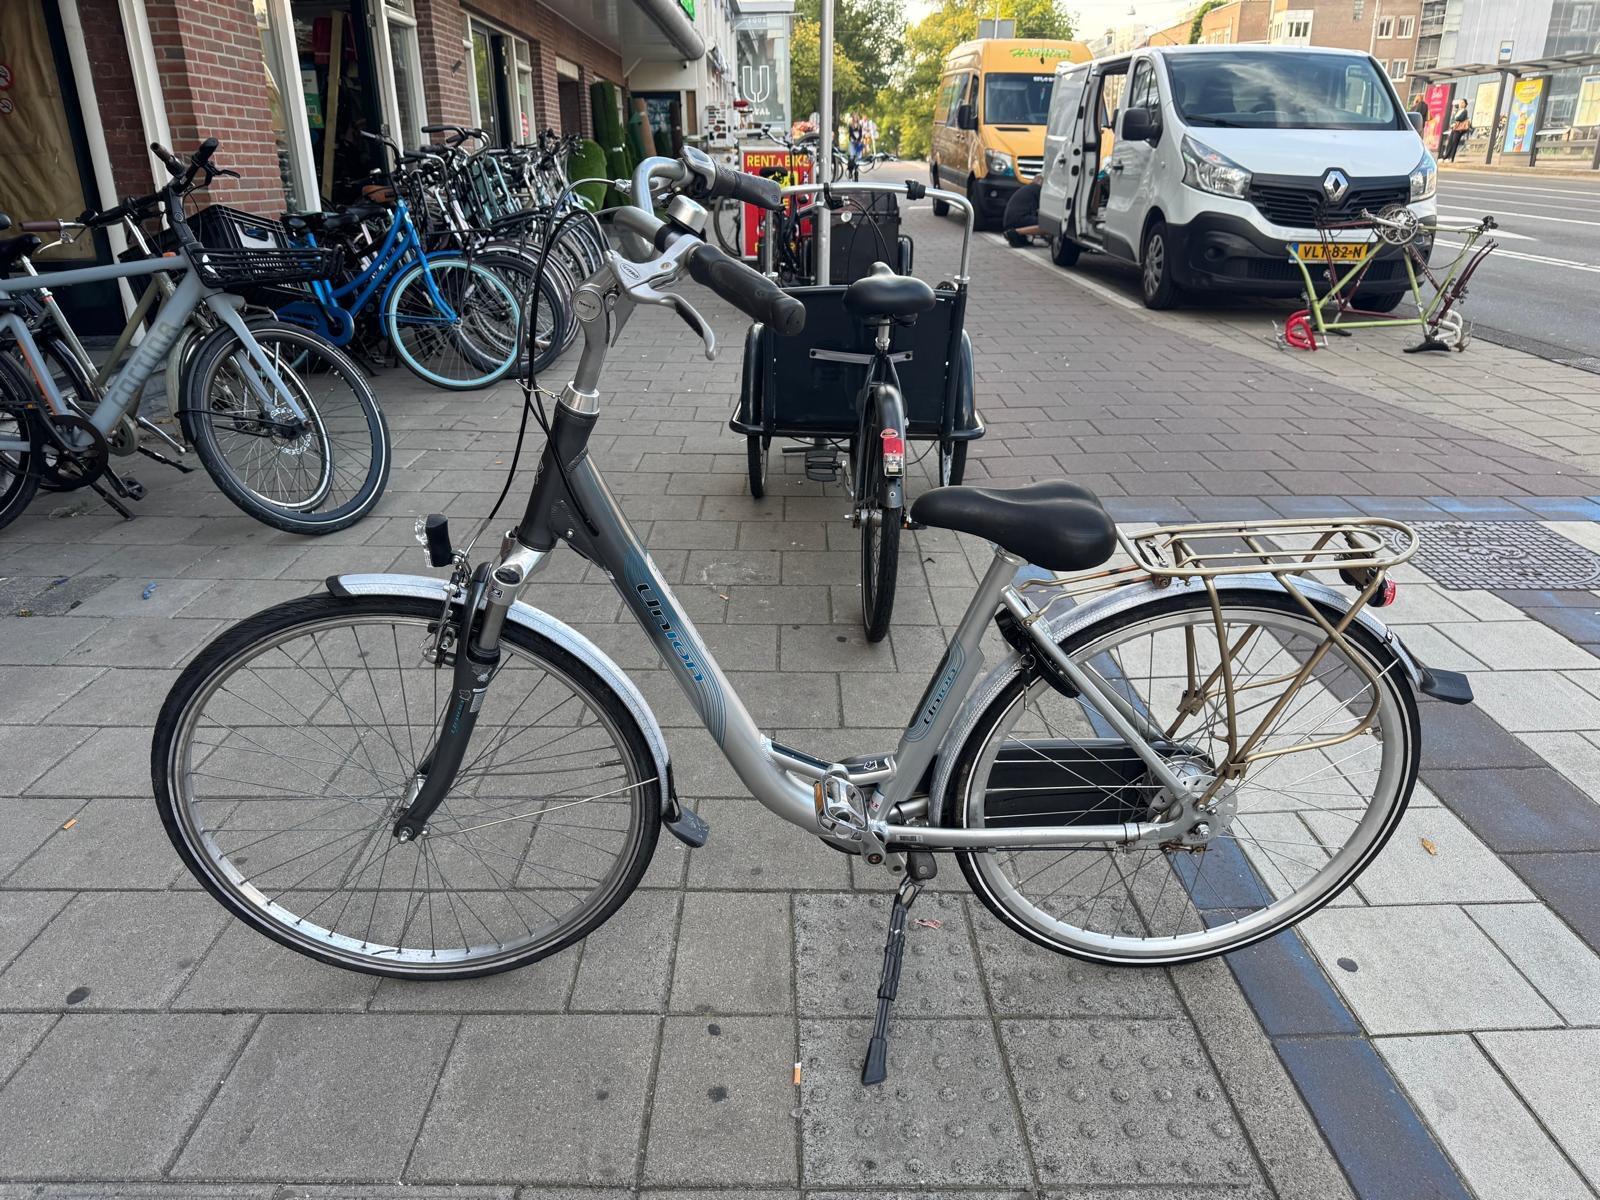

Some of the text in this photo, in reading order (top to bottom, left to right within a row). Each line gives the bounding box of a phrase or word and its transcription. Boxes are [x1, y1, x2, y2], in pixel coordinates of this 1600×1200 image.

[746, 155, 775, 167] RENT
[776, 158, 784, 167] A
[636, 583, 704, 682] Union
